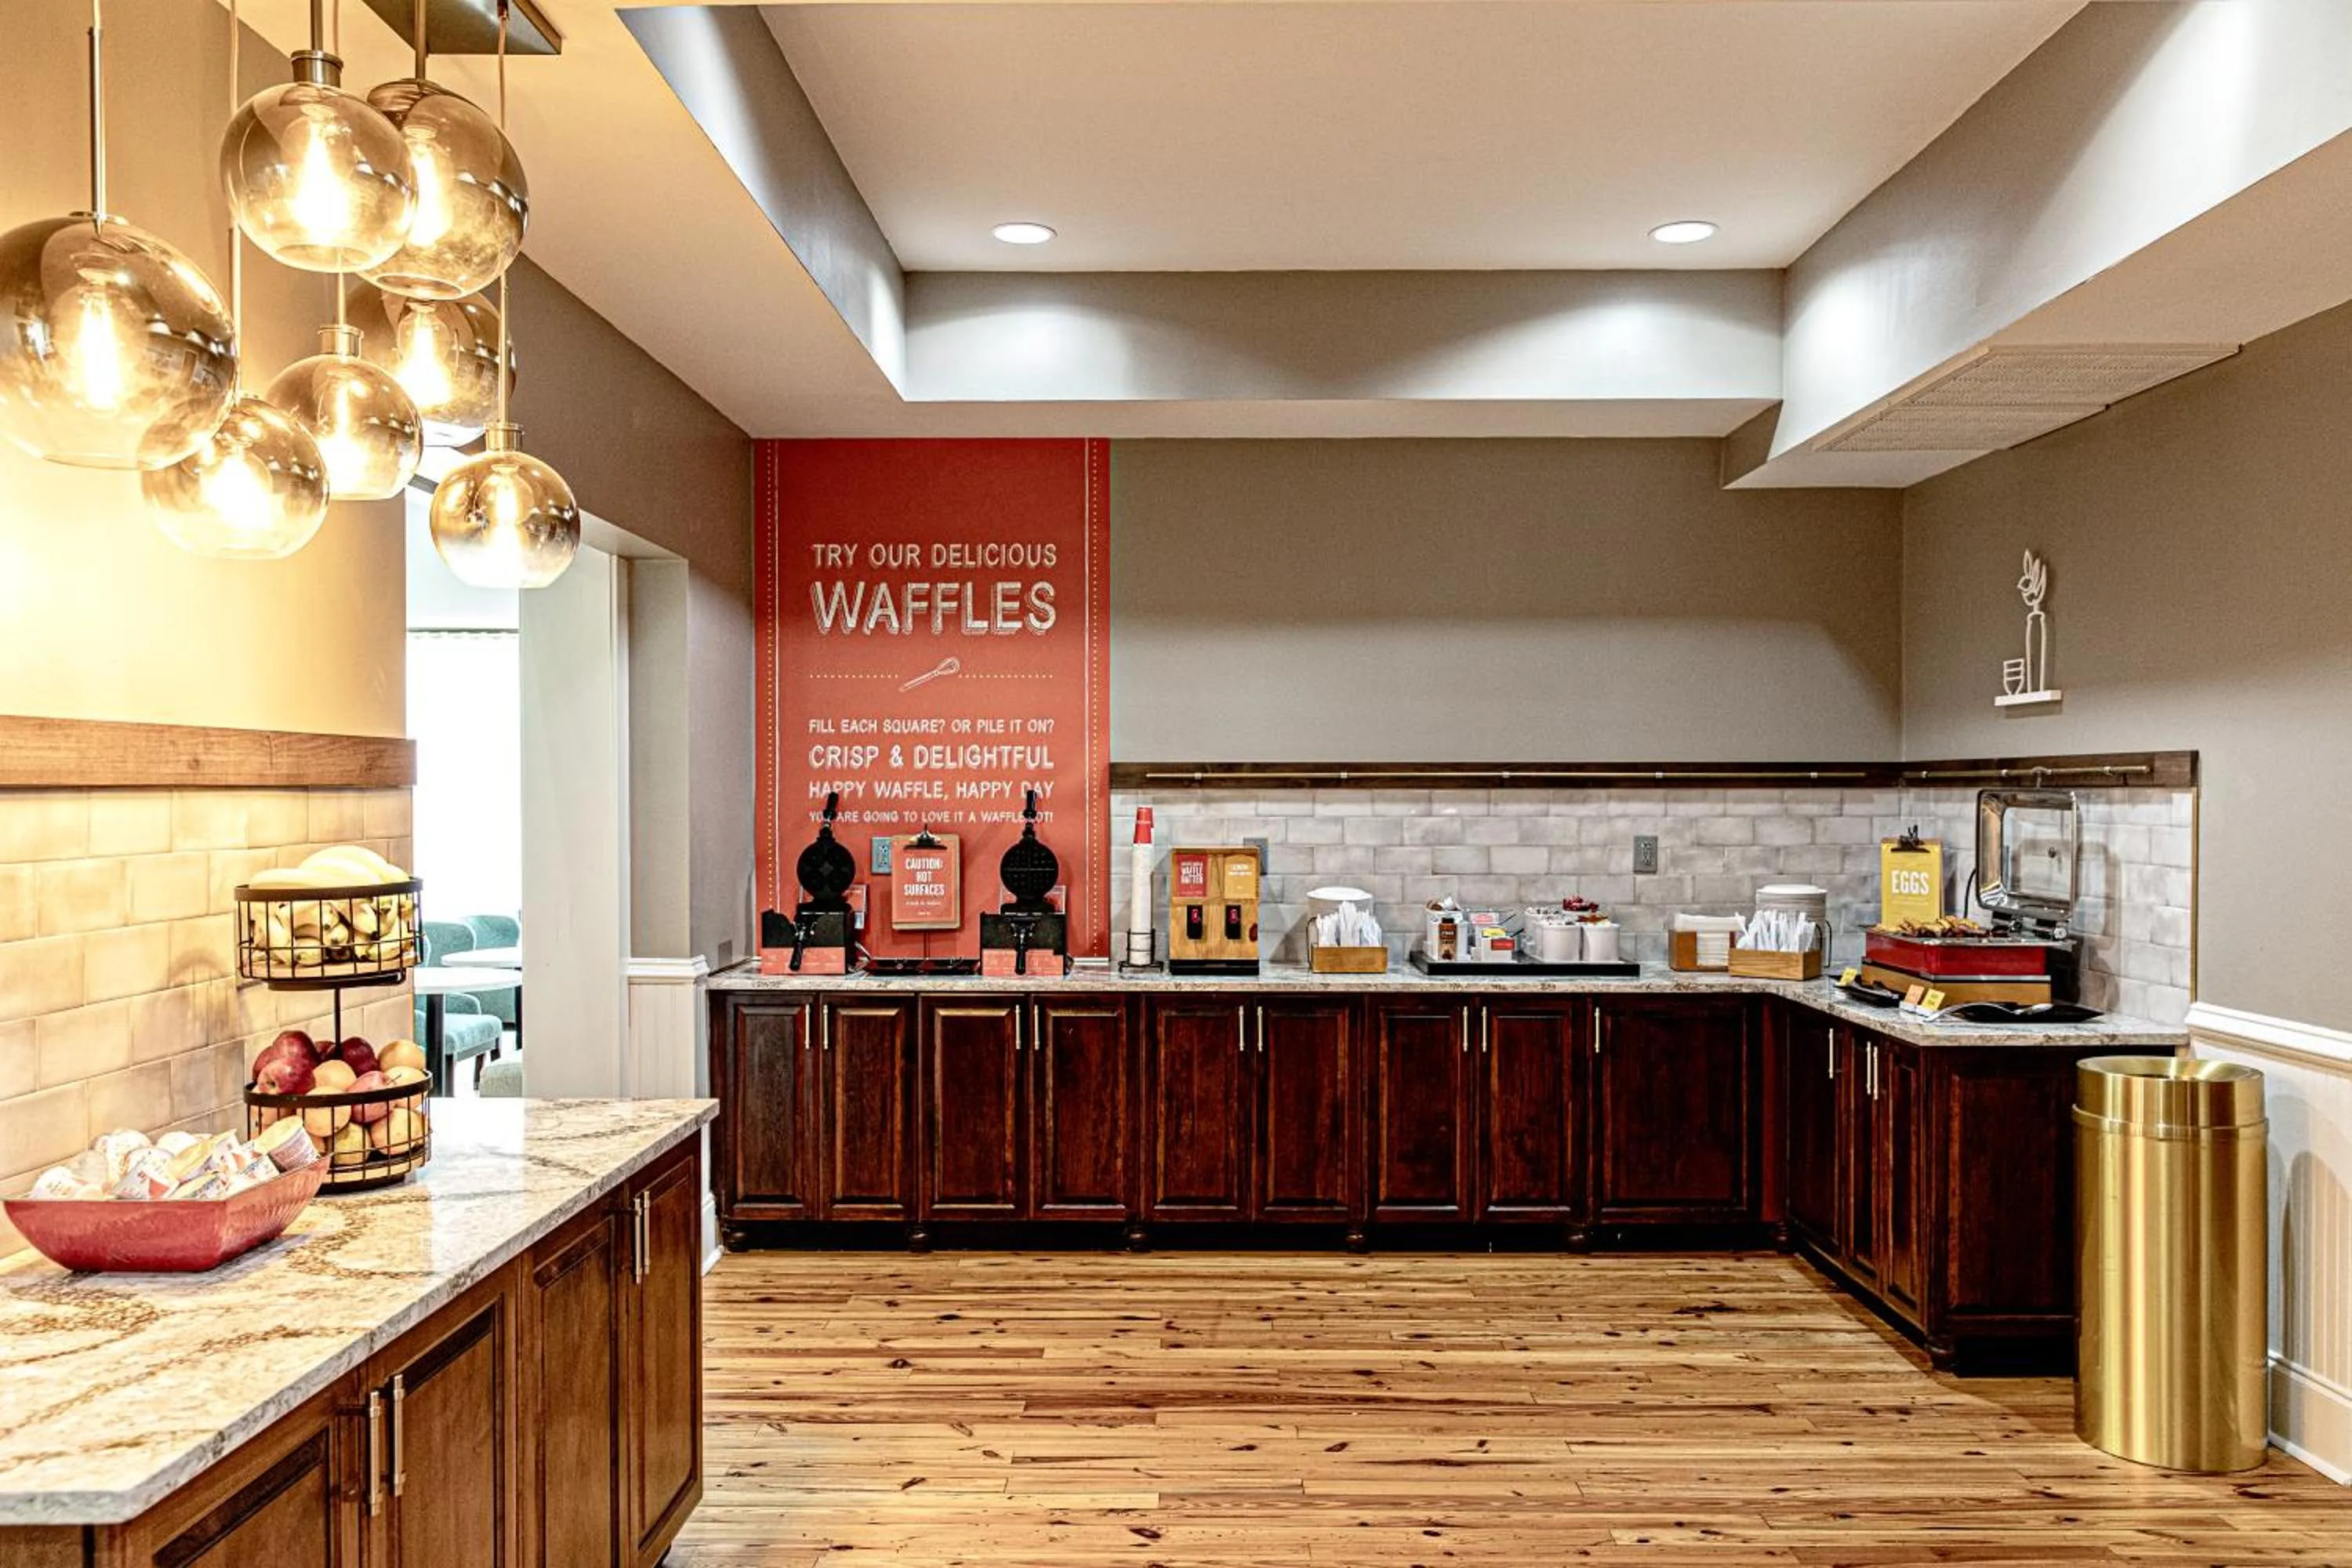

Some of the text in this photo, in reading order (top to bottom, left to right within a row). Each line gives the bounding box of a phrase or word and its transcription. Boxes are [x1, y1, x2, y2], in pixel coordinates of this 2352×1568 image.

[810, 543, 1057, 568] TRY OUR DELICIOUS
[810, 580, 1056, 635] WAFFLES
[808, 719, 1054, 734] FILL EACH SQUARE? OR PILE IT ON?
[809, 744, 1054, 769] CRISP & DELIGHTFUL
[809, 780, 1054, 801] HAPPY WAFFLE, HAPPY DAY
[809, 811, 831, 822] YO
[836, 811, 859, 822] ARE
[863, 811, 898, 822] GOING
[903, 811, 917, 822] TO
[922, 811, 949, 822] LOVE
[954, 811, 964, 822] IT
[968, 811, 976, 822] A
[916, 871, 932, 883] HOT
[1892, 869, 1929, 895] EGGS
[904, 884, 945, 896] SURFACES
